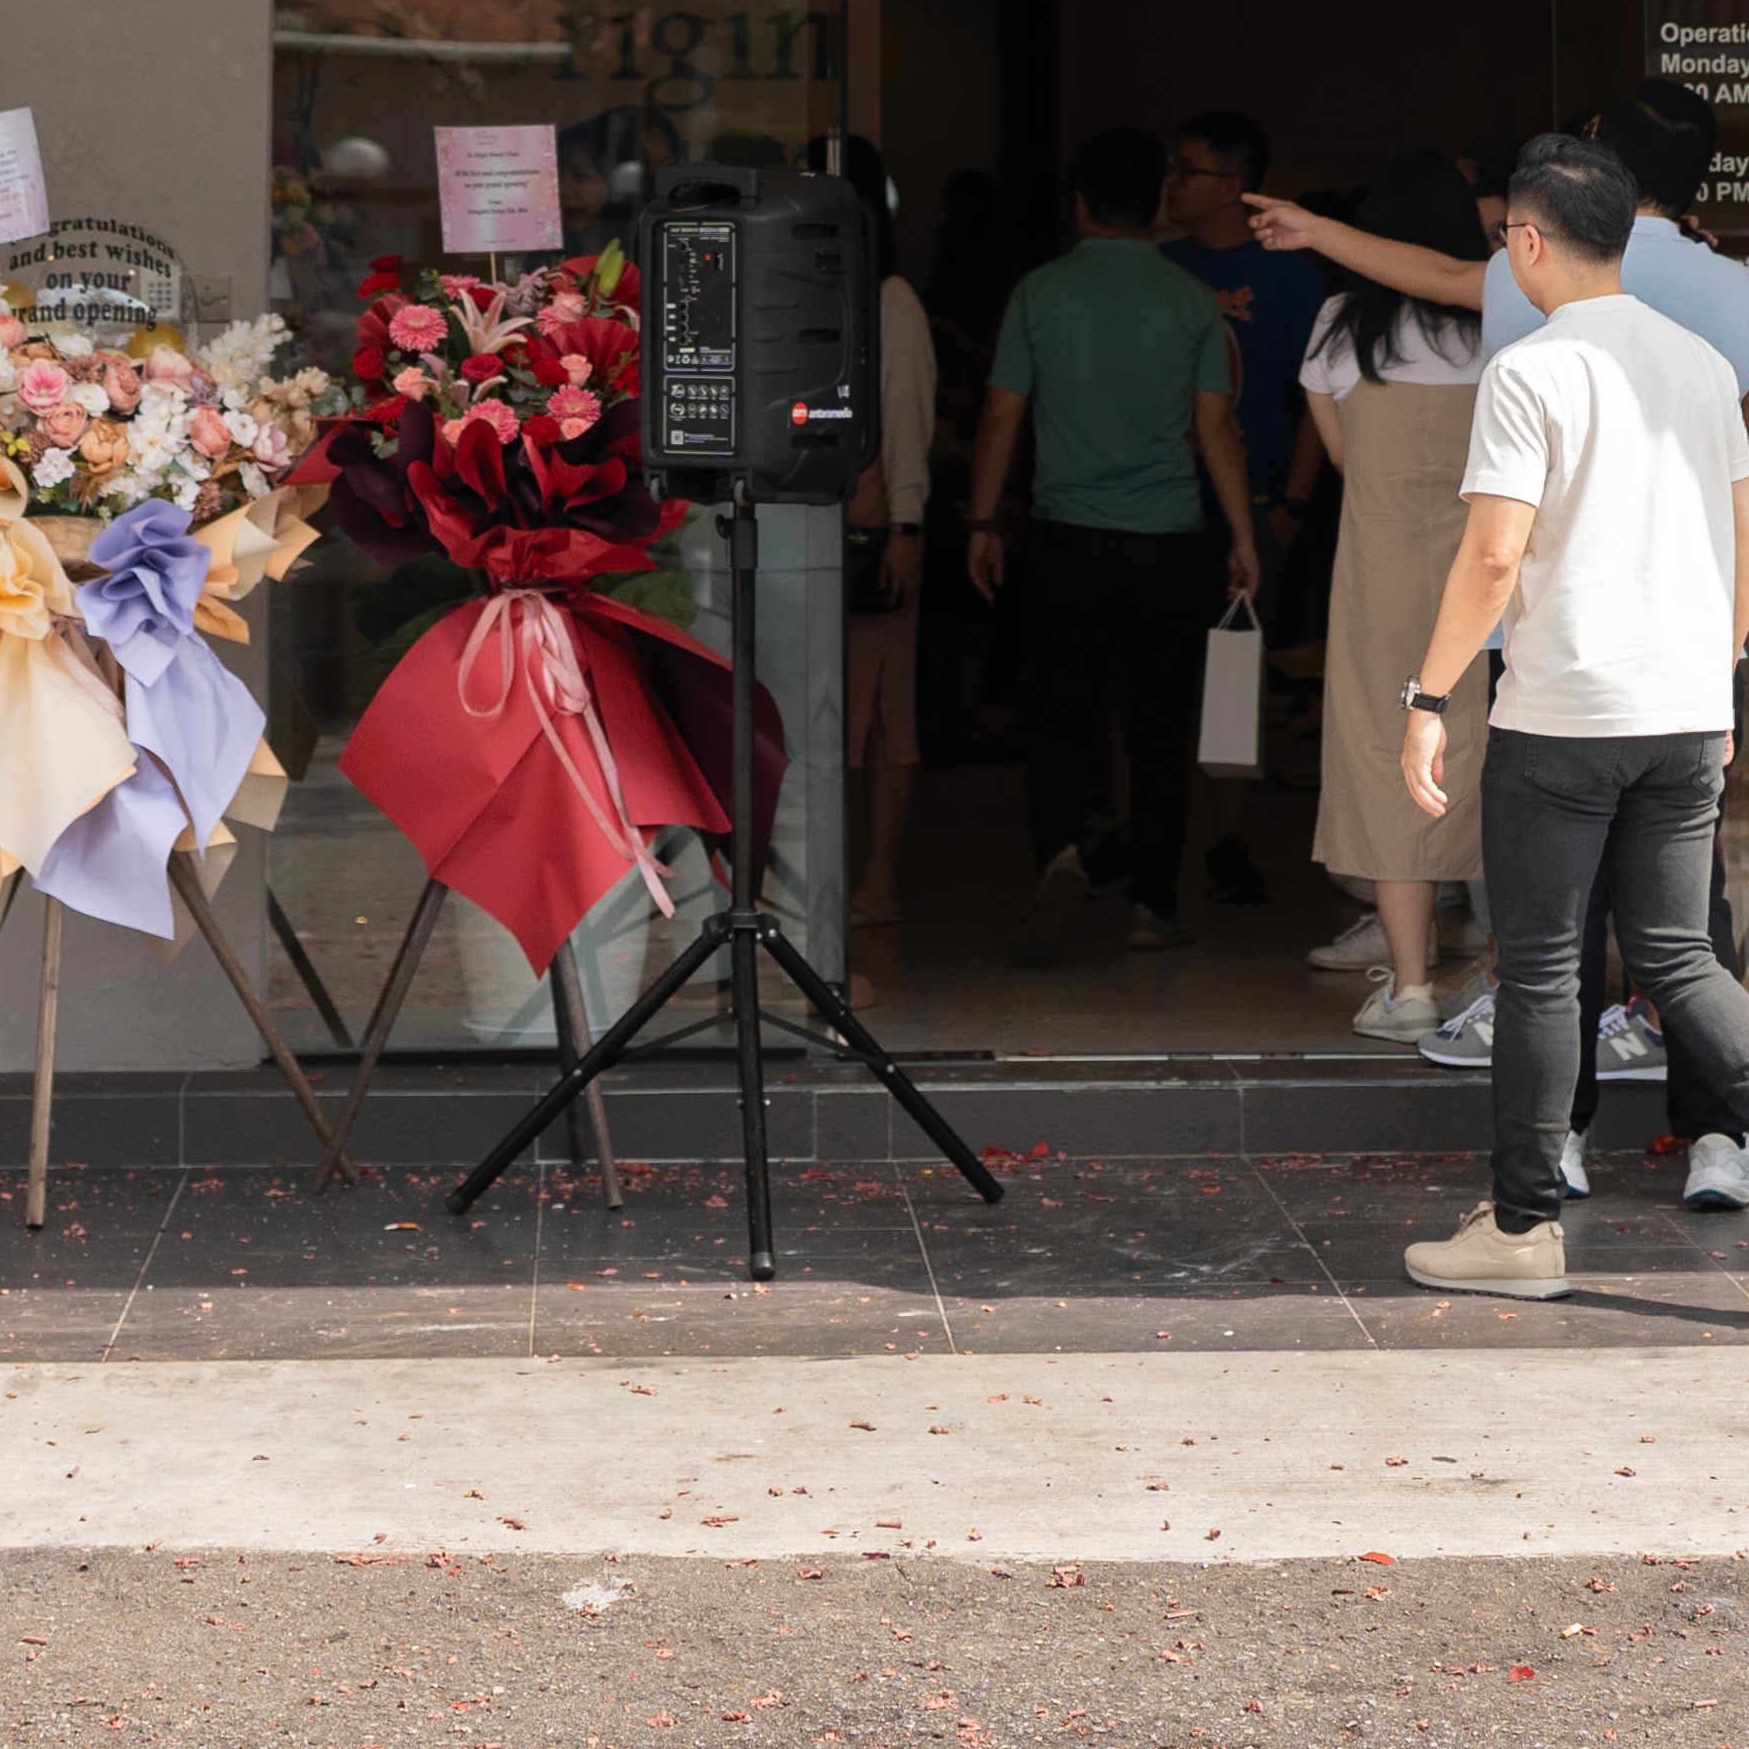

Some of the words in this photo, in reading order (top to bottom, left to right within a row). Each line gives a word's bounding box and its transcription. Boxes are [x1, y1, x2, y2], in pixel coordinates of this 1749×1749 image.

[1708, 152, 1749, 177] day
[47, 217, 176, 261] gratulations
[8, 242, 47, 271] and
[52, 240, 99, 261] best
[104, 243, 172, 279] wishes
[46, 271, 74, 291] on
[79, 271, 132, 294] your
[10, 297, 67, 325] rand
[72, 298, 159, 333] opening
